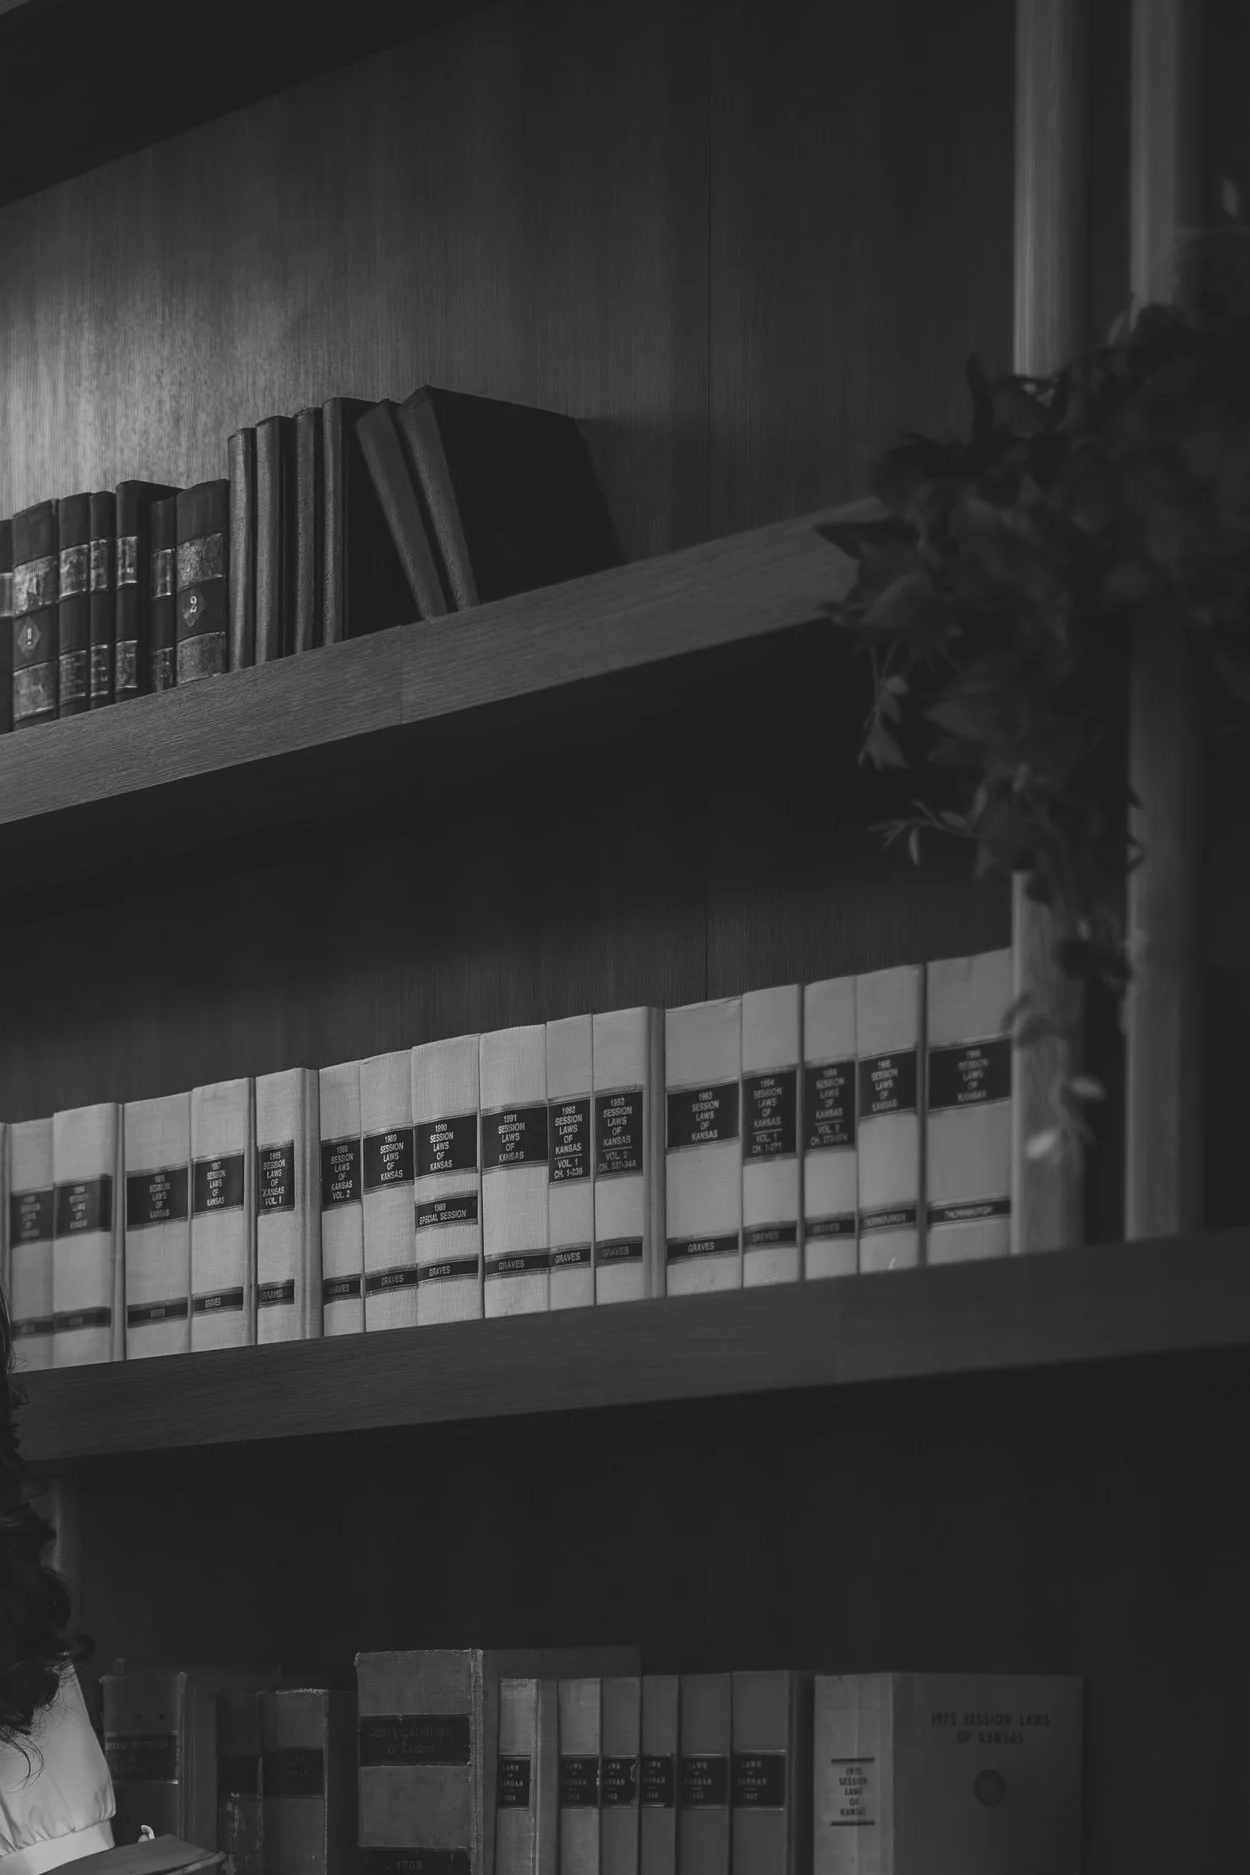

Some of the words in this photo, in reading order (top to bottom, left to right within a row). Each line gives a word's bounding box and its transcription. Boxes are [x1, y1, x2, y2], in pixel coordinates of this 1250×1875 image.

[190, 596, 197, 613] 2
[958, 1059, 988, 1070] SESSION
[871, 1069, 898, 1081] SESSION
[963, 1071, 983, 1081] LAWS
[816, 1078, 845, 1089] SESSION
[875, 1080, 893, 1091] LAWS
[699, 1092, 712, 1100] 1993
[754, 1088, 782, 1099] SESSION
[820, 1089, 839, 1098] LAWS
[879, 1091, 889, 1100] OF
[610, 1098, 625, 1106] 1992
[692, 1101, 719, 1112] SESSION
[758, 1099, 777, 1107] LAWS
[825, 1099, 834, 1108] OF
[872, 1100, 897, 1111] KANSAS
[562, 1106, 575, 1114] 1992
[603, 1107, 632, 1117] SESSION
[762, 1109, 772, 1117] OF
[815, 1108, 843, 1119] KANSAS
[555, 1114, 582, 1126] SESSION
[696, 1112, 714, 1121] LAWS
[607, 1117, 627, 1126] LAWS
[701, 1122, 709, 1130] OF
[754, 1117, 781, 1127] KANSAS
[435, 1124, 447, 1132] 1990
[498, 1123, 525, 1134] SESSION
[559, 1125, 578, 1135] LAWS
[612, 1127, 621, 1135] OF
[385, 1134, 397, 1143] 1989
[430, 1132, 453, 1143] SESSION
[502, 1134, 520, 1143] LAWS
[564, 1135, 573, 1143] OF
[692, 1130, 718, 1141] KANSAS
[756, 1134, 771, 1142] VOL.
[604, 1136, 631, 1146] KANSAS
[380, 1142, 404, 1154] SESSION
[433, 1142, 449, 1151] LAWS
[506, 1143, 514, 1151] OF
[556, 1143, 581, 1154] KANSAS
[753, 1145, 763, 1153] CH.
[331, 1153, 353, 1164] SESSION
[383, 1152, 399, 1162] LAWS
[437, 1152, 445, 1160] OF
[499, 1151, 524, 1162] KANSAS
[606, 1151, 620, 1160] VOL.
[263, 1159, 285, 1170] SESSION
[335, 1163, 350, 1172] LAWS
[387, 1162, 394, 1170] OF
[430, 1160, 452, 1171] KANSAS
[558, 1159, 573, 1168] VOL.
[599, 1163, 610, 1171] CH.
[207, 1170, 226, 1180] SESSION
[267, 1169, 282, 1178] LAWS
[381, 1171, 403, 1182] KANSAS
[554, 1170, 565, 1179] CH.
[210, 1179, 222, 1188] LAWS
[332, 1180, 352, 1192] KANSAS
[152, 1192, 166, 1200] LAWS
[263, 1186, 284, 1197] KANSAS
[332, 1191, 345, 1199] VOL.
[156, 1201, 163, 1209] OF
[207, 1197, 225, 1206] KANSAS
[434, 1203, 446, 1211] 1989
[420, 1213, 438, 1224] SPECIAL
[440, 1210, 466, 1221] SESSION
[812, 1223, 840, 1233] GRAVES
[753, 1232, 779, 1242] GRAVES
[602, 1247, 629, 1257] GRAVES
[687, 1243, 714, 1252] GRAVES
[555, 1253, 580, 1263] GRAVES
[499, 1260, 524, 1269] GRAVES
[429, 1266, 450, 1276] GRAVES
[381, 1275, 404, 1286] GRAVES
[262, 1289, 283, 1299] GRAVES
[205, 1297, 221, 1308] GRAVES
[931, 1712, 957, 1726] 1975
[962, 1712, 1012, 1726] SESSION
[1019, 1712, 1050, 1727] LAWS
[957, 1731, 972, 1744] OF
[978, 1731, 1024, 1744] KANSAS
[688, 1762, 707, 1770] LAWS
[839, 1777, 868, 1786] SESSION
[844, 1787, 863, 1796] LAWS
[840, 1807, 866, 1816] KANSAS
